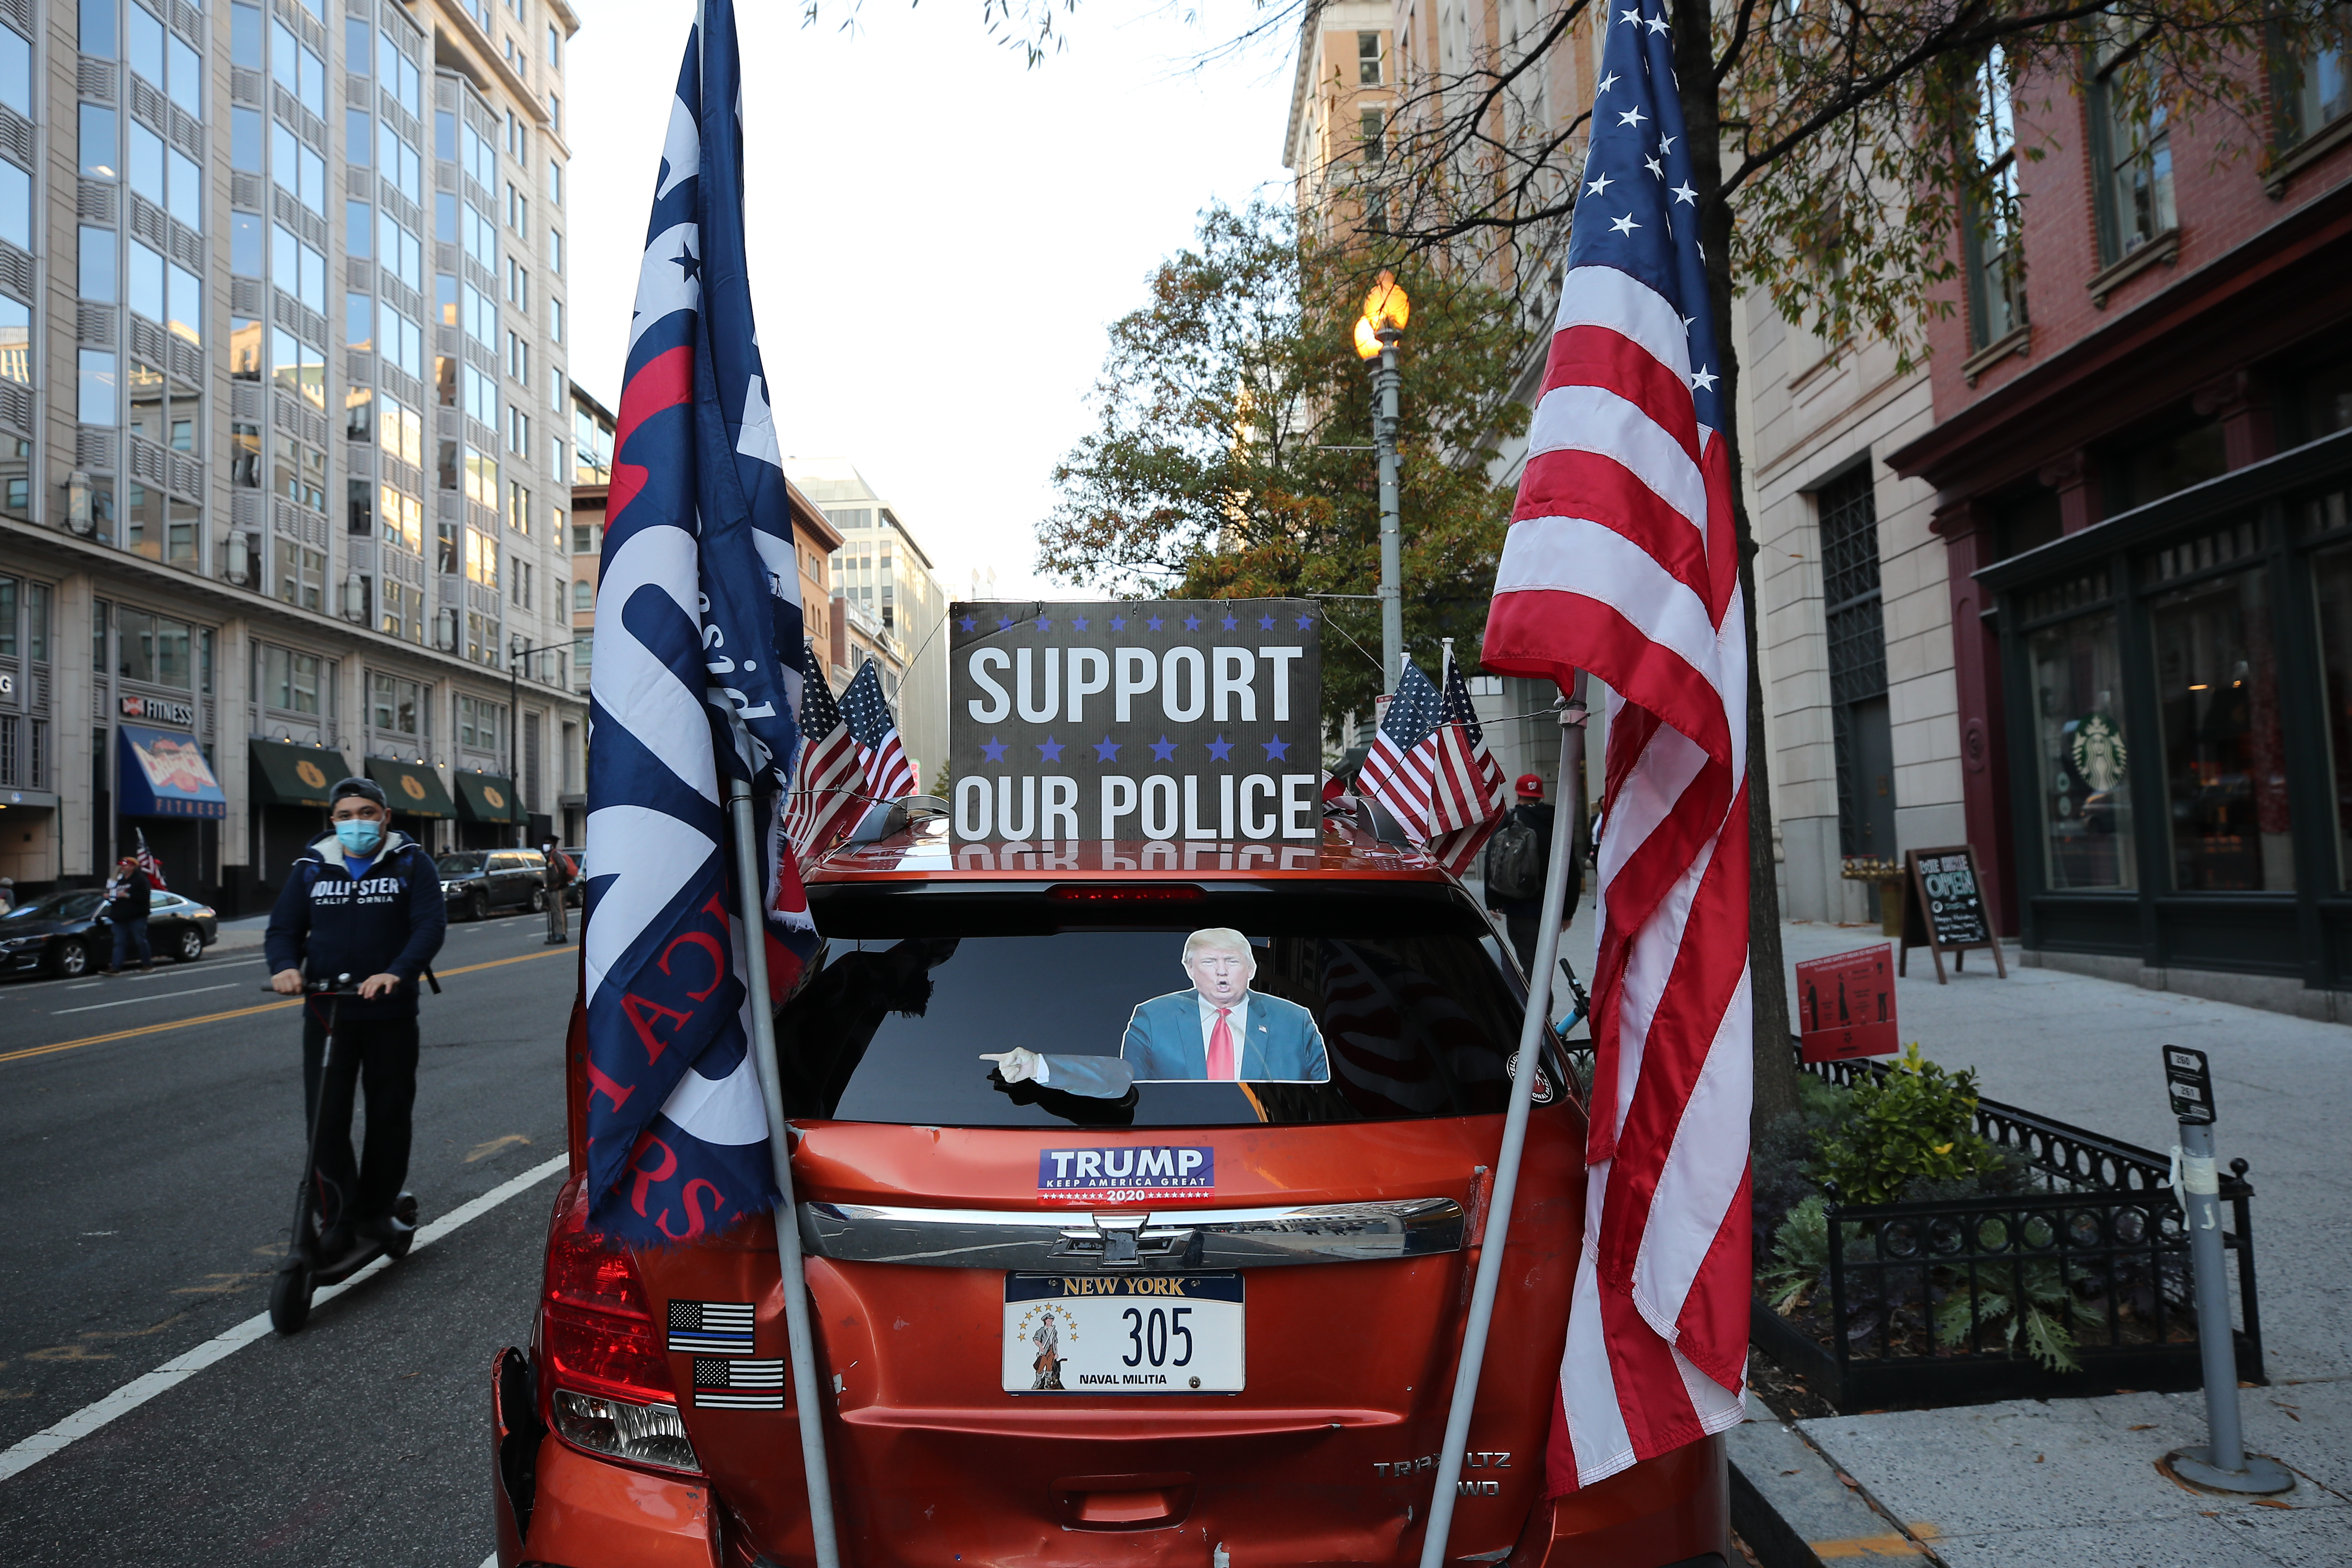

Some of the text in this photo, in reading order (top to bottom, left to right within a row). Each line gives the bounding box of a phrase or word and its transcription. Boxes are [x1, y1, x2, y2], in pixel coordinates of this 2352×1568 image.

[968, 645, 1303, 724] SUPPORT
[146, 699, 194, 724] FITNESS
[156, 798, 225, 816] FITNESS
[954, 773, 1316, 842] OUR POLICE
[1918, 859, 1940, 874] WE
[1926, 870, 1975, 897] OPEN
[2176, 1055, 2190, 1065] 260
[2180, 1086, 2194, 1097] 261
[1051, 1149, 1203, 1178] TRUMP
[1089, 1178, 1152, 1187] AMERICA
[1162, 1177, 1206, 1186] GREAT
[1107, 1190, 1145, 1201] 2020
[1063, 1278, 1185, 1296] NEW YORK
[1122, 1307, 1193, 1367] 305
[1079, 1374, 1167, 1385] NAVAL MILITIA
[1467, 1452, 1511, 1468] LTZ
[1457, 1481, 1499, 1497] WD
